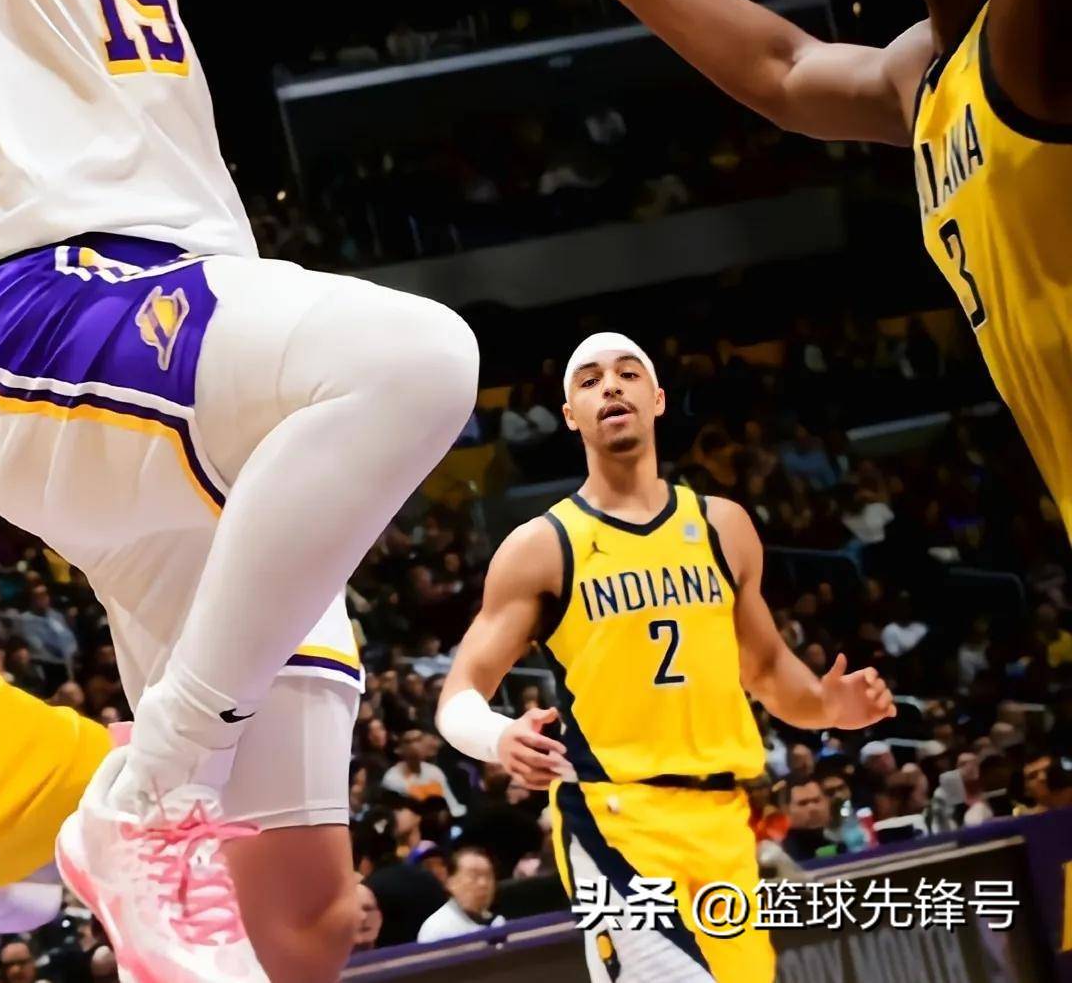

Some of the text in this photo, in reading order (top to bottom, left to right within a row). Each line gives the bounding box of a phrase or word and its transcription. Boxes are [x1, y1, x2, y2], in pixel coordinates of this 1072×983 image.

[938, 217, 988, 329] 3
[580, 564, 724, 622] INDIANA
[647, 619, 686, 686] 2
